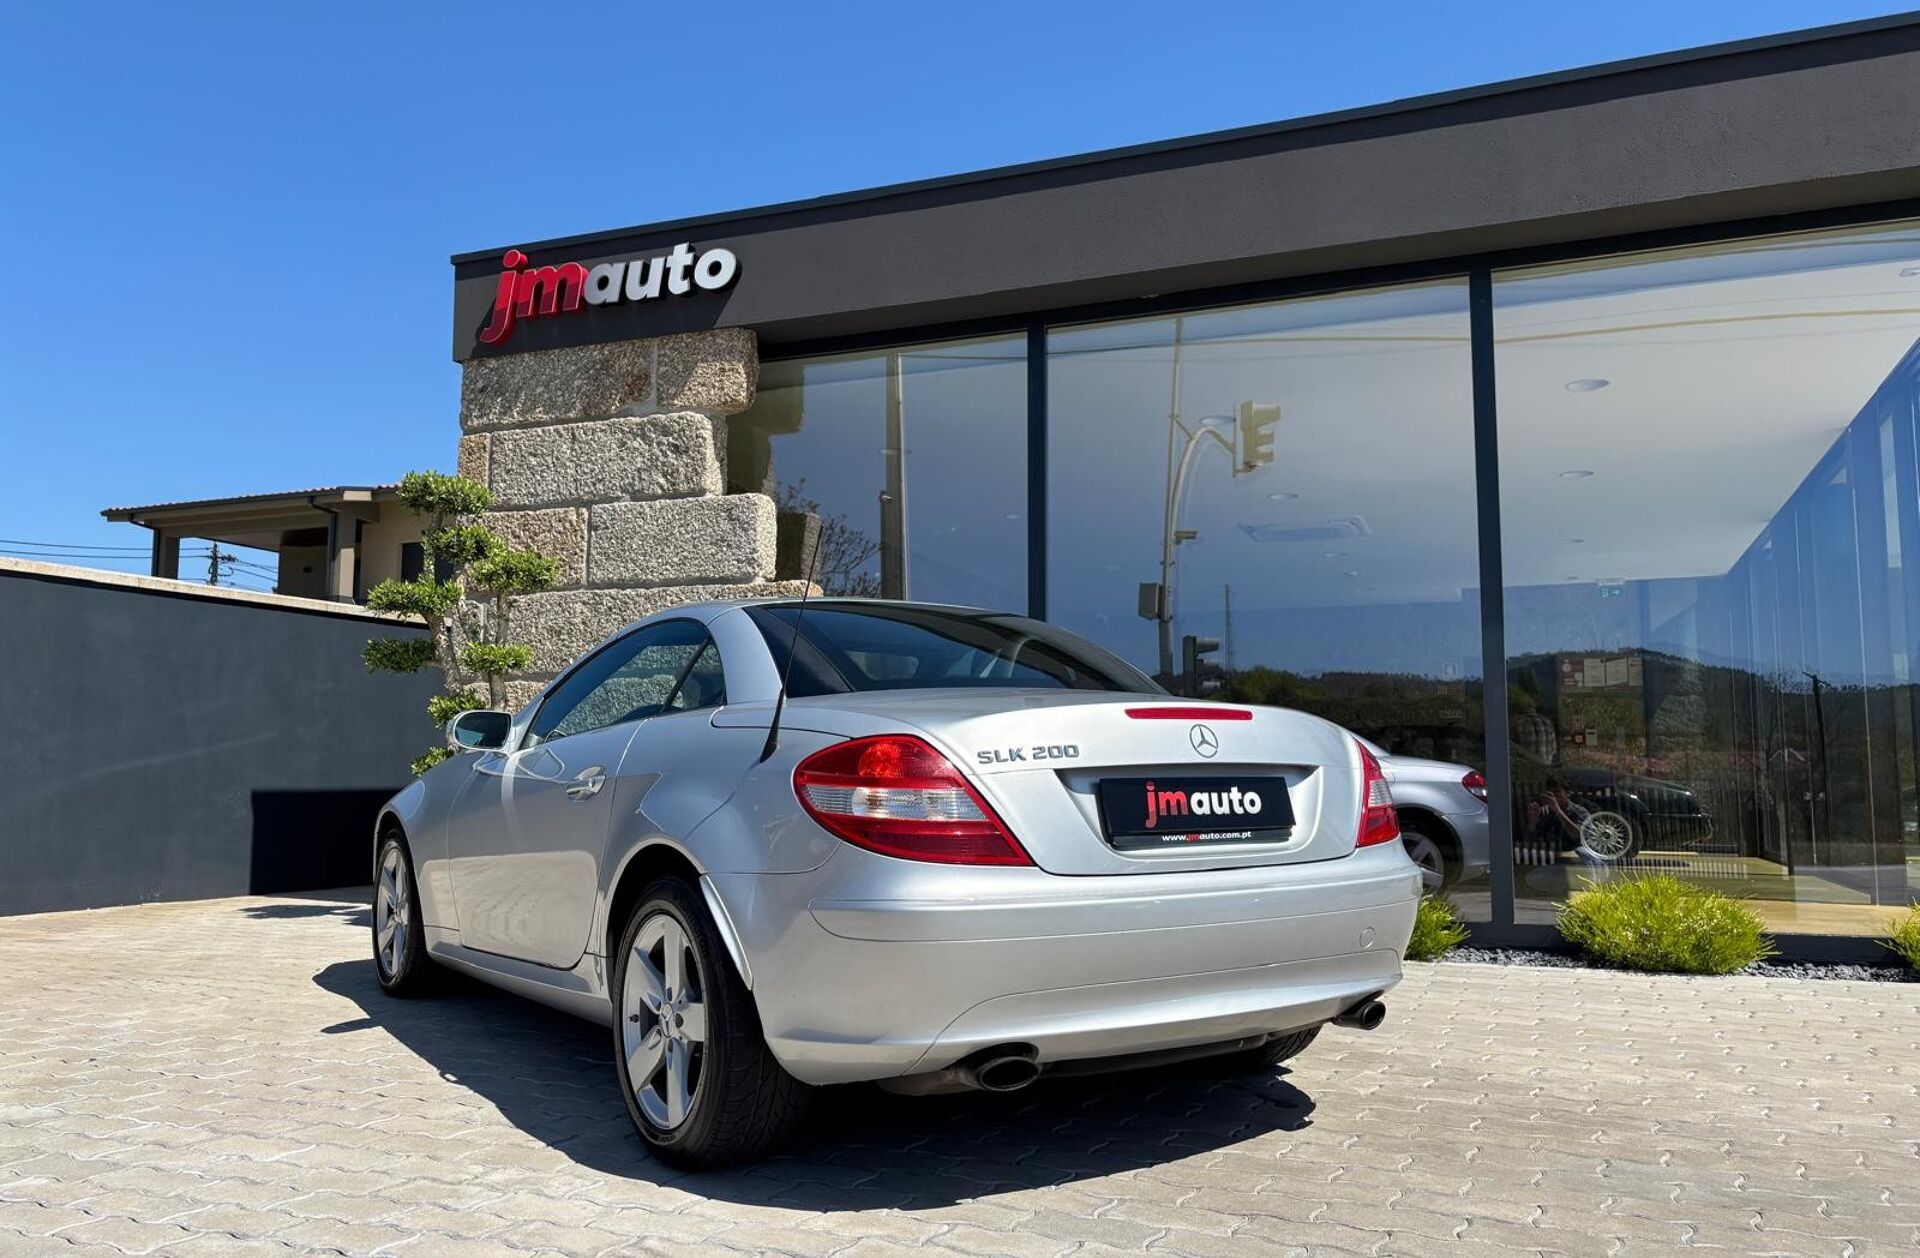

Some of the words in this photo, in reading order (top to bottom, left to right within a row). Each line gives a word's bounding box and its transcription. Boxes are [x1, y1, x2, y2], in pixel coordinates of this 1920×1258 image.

[479, 241, 738, 345] jmauto
[977, 747, 1027, 764] SLK
[1032, 744, 1080, 760] 200
[1145, 781, 1263, 828] jmauto
[1161, 831, 1252, 842] www.jmauto.com.pt
